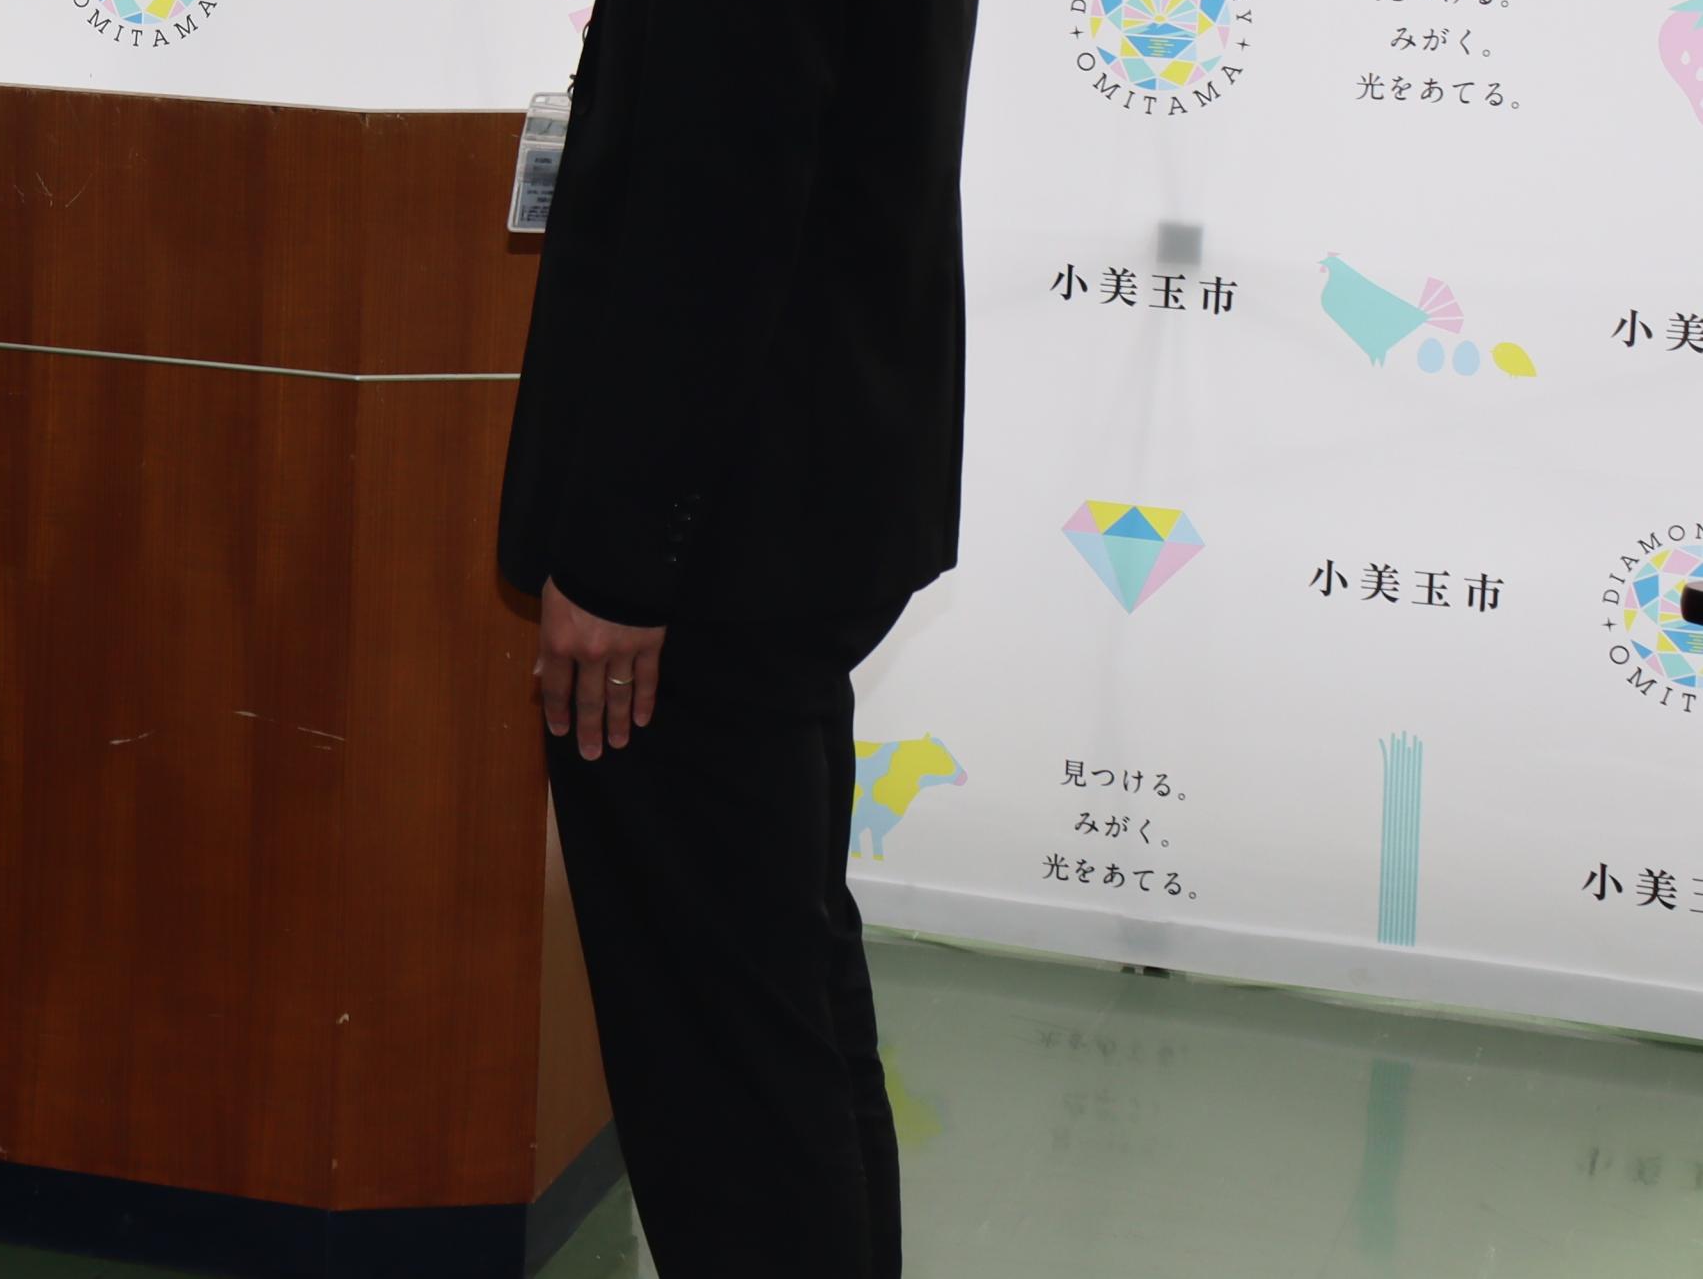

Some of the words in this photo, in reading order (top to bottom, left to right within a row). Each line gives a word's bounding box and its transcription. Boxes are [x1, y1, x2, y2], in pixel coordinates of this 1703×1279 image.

[1390, 27, 1492, 58] みがく。
[1076, 52, 1244, 116] OMITAMA
[1356, 72, 1521, 110] 光をあてる。
[1049, 264, 1238, 316] 小美玉市
[1308, 558, 1505, 613] 小美玉市
[1602, 522, 1703, 606] DIAMO
[1609, 644, 1698, 713] OMIT
[1061, 759, 1187, 801] 見つける。
[1074, 811, 1170, 848] みがく。
[1042, 852, 1198, 900] 光をあてる。
[1582, 862, 1703, 914] 小美
